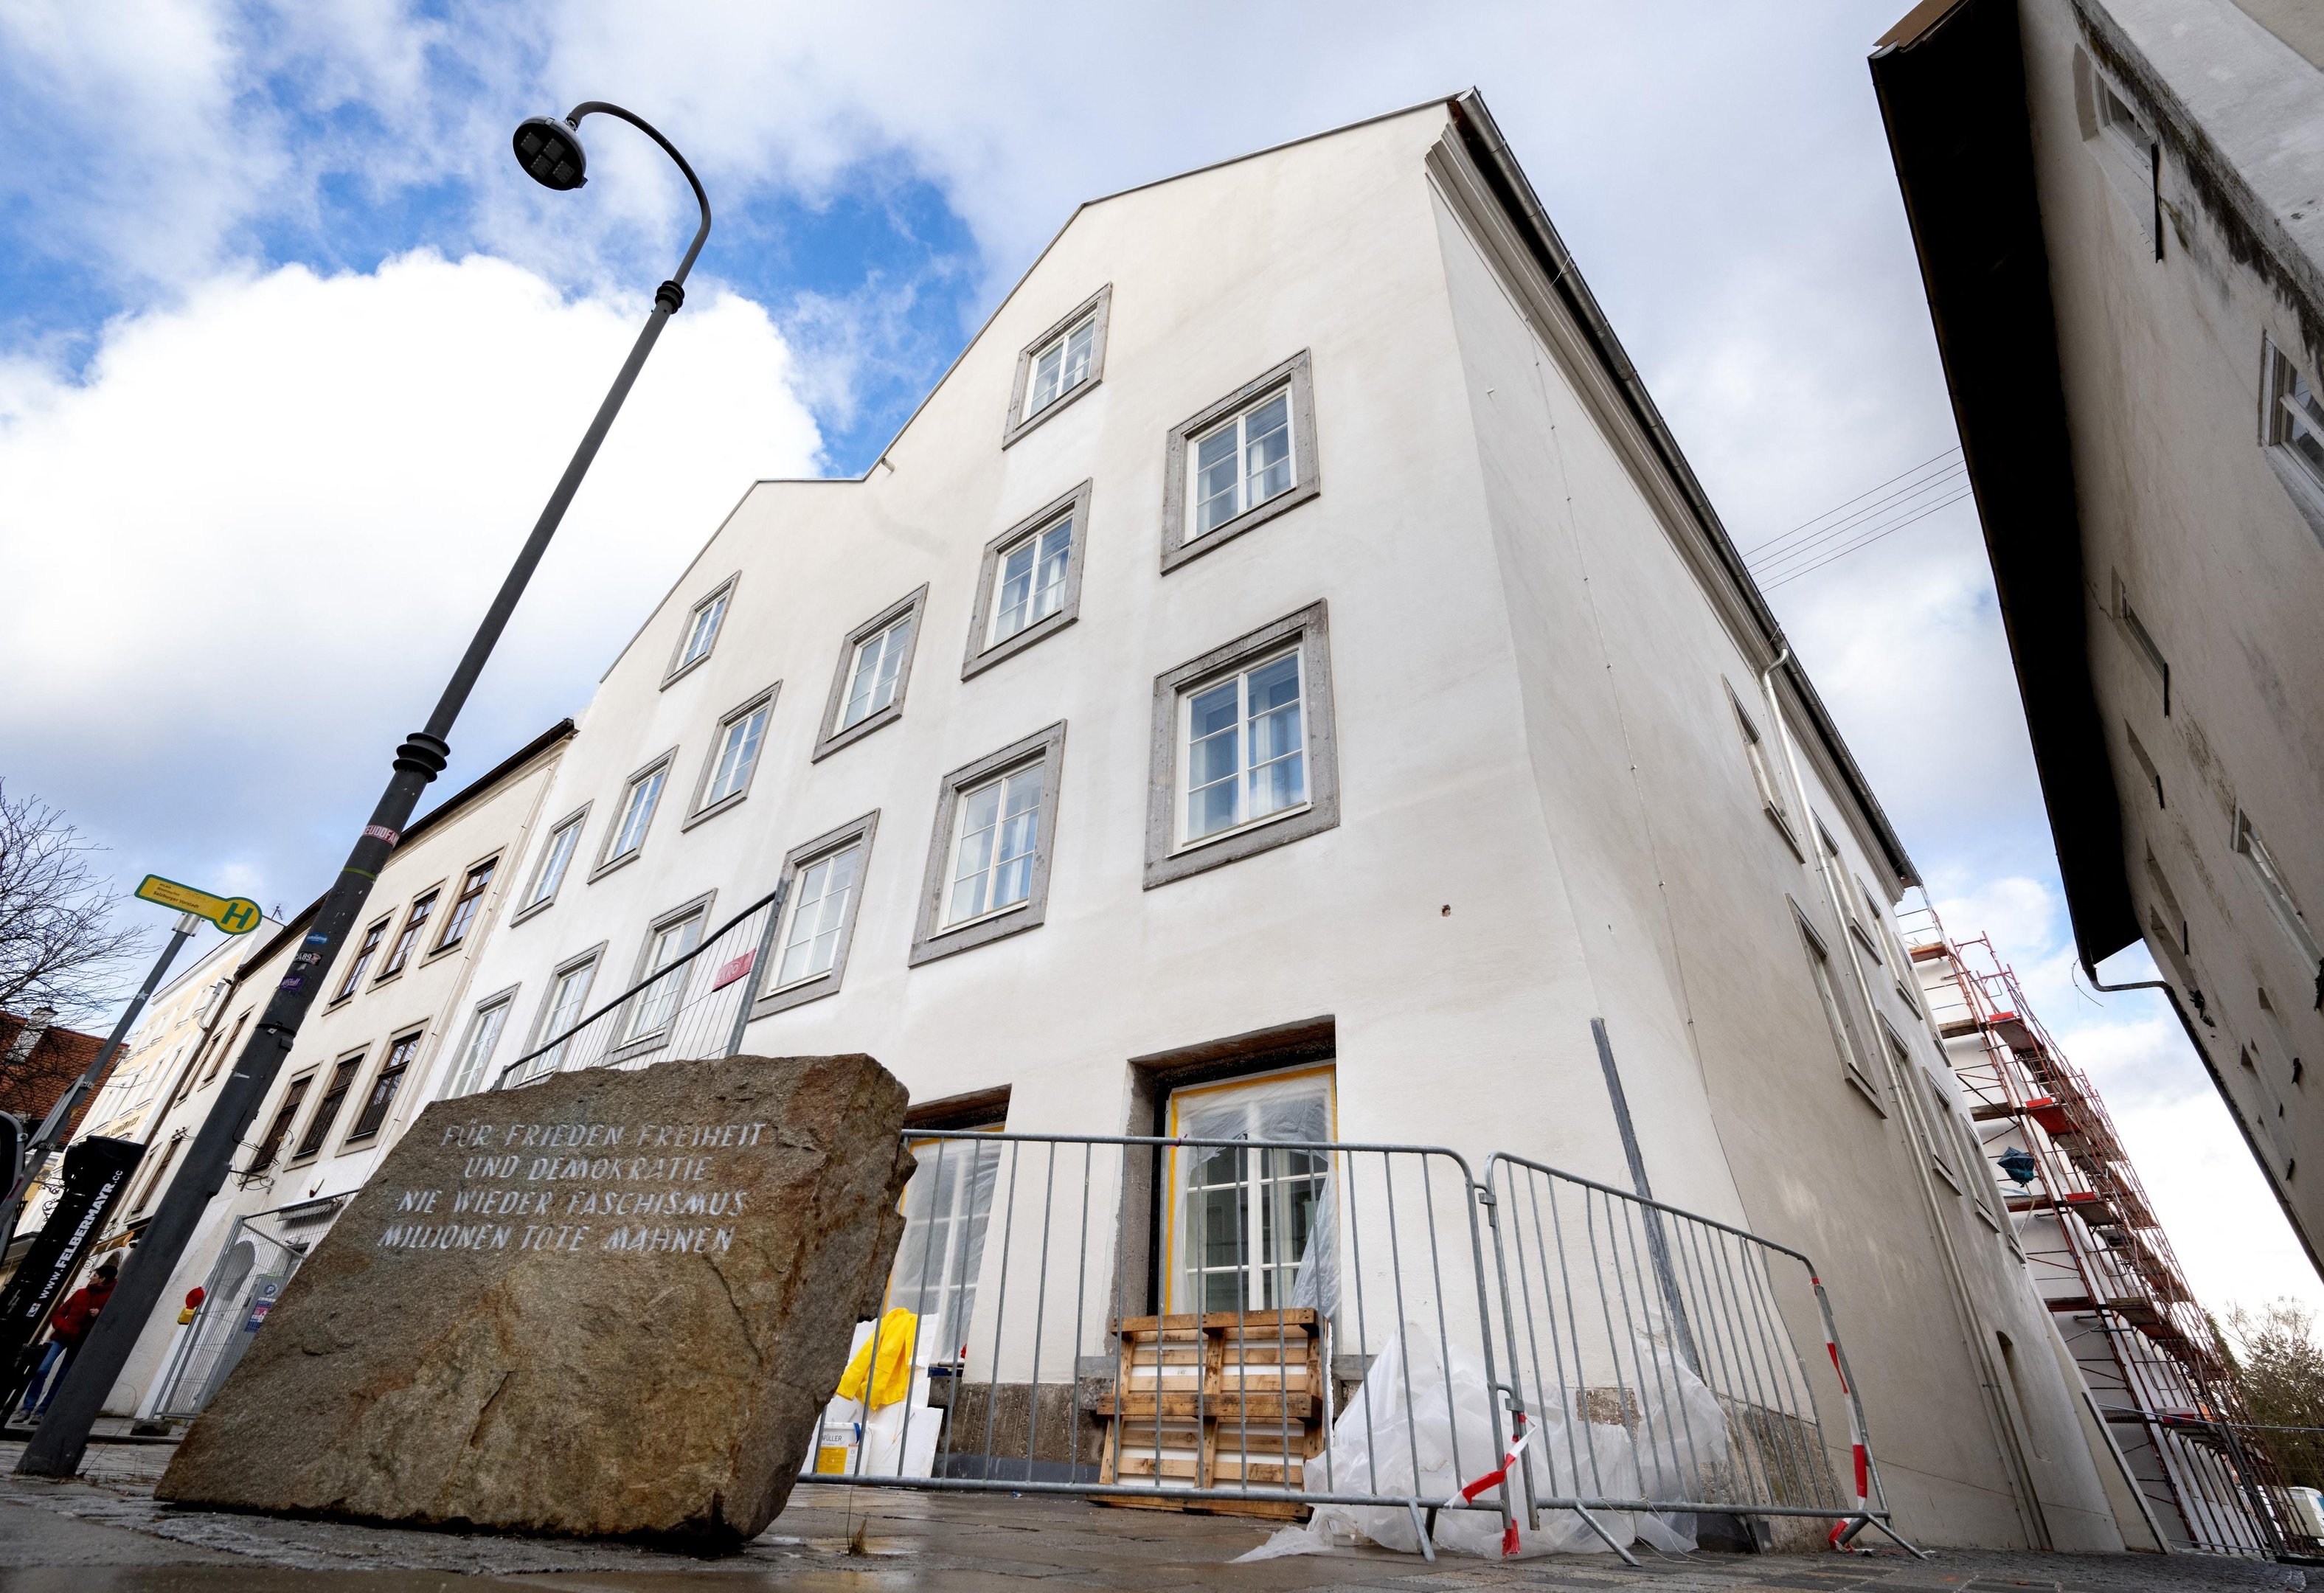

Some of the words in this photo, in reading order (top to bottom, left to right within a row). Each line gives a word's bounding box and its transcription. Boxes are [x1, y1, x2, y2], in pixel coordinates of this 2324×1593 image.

[153, 890, 178, 903] Salzburger
[179, 898, 200, 909] Vorstadt
[221, 902, 254, 930] H
[440, 1118, 493, 1147] FÜR
[504, 1123, 625, 1147] FRIEDEN
[637, 1122, 766, 1147] FREIHEIT
[465, 1156, 519, 1179] UND
[527, 1156, 713, 1180] DEMOKRATIE
[397, 1190, 443, 1213] NIE
[454, 1190, 553, 1215] WIEDER
[566, 1190, 748, 1216] FASCHISMUS
[38, 1170, 124, 1299] www.FELBERMAYR.cc
[377, 1224, 513, 1250] MILLIONEN
[519, 1224, 589, 1251] TOTE
[603, 1225, 735, 1253] MAHNEN
